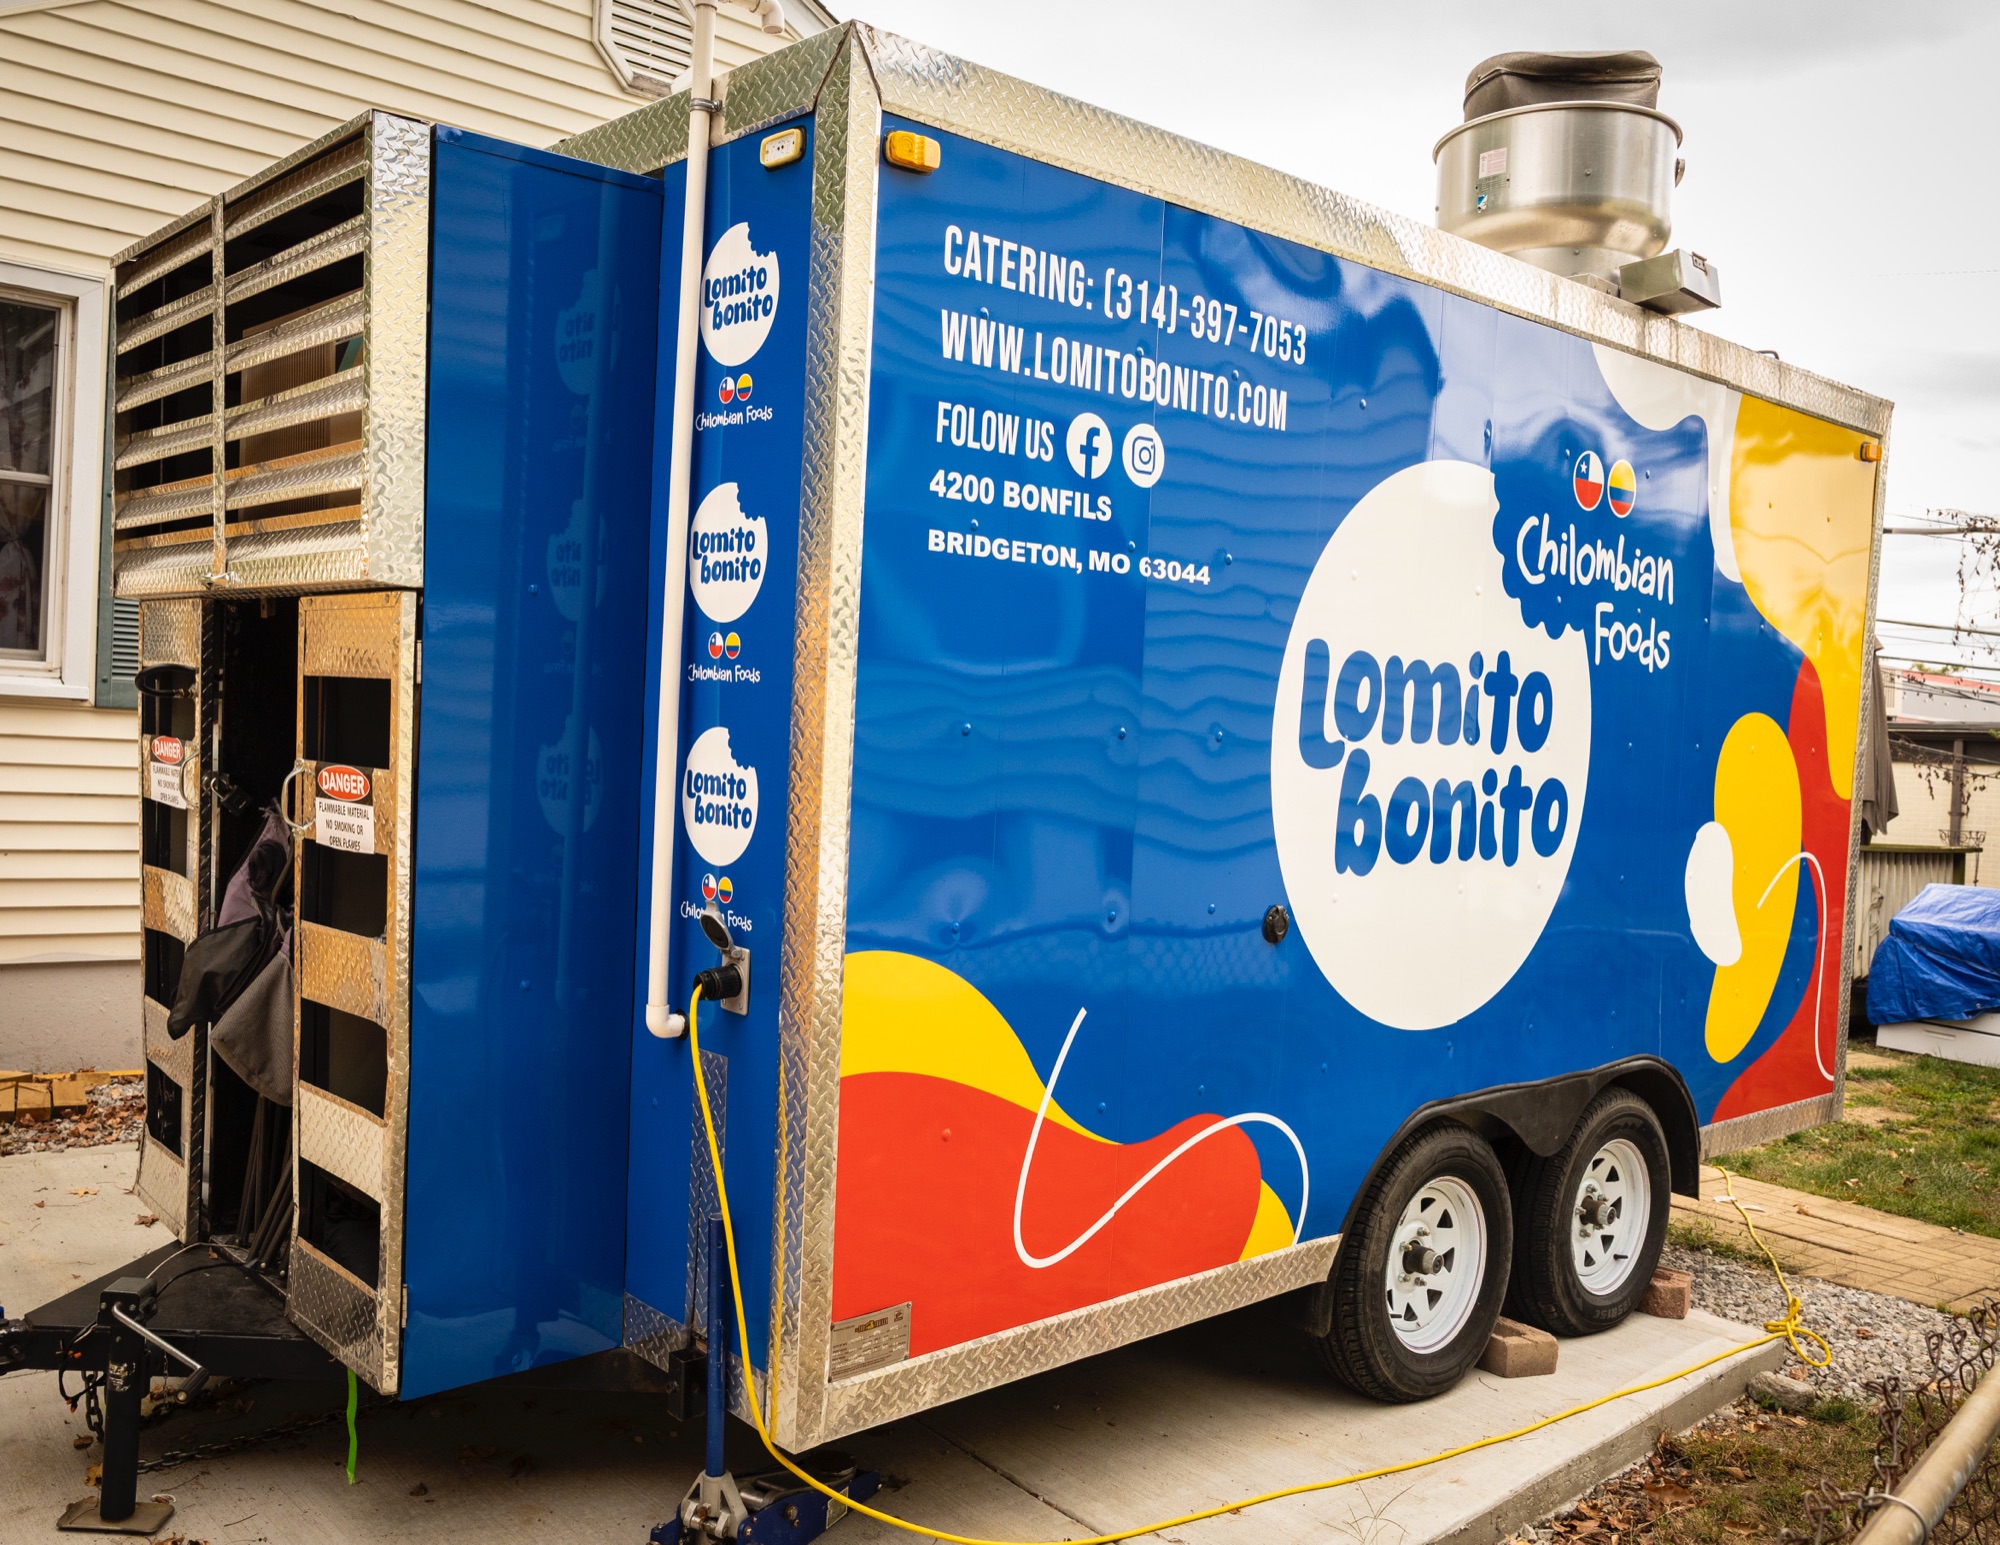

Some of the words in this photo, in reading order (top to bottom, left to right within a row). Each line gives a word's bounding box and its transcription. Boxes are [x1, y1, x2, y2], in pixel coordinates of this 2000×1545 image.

[704, 265, 767, 308] Lomito
[943, 225, 1094, 311] CATERING:
[1102, 267, 1307, 366] (314)-397-7053
[712, 293, 773, 331] bonito
[941, 308, 1288, 432] WWW.LOMITOBONITO.COM
[695, 410, 743, 431] Chilombian
[746, 405, 773, 422] Foods
[936, 400, 1019, 457] FOLOW
[1025, 420, 1055, 463] US
[929, 469, 995, 505] 4200
[1003, 480, 1112, 522] BONFILS
[693, 526, 755, 560] Lomito
[927, 530, 1082, 575] BRIDGETON,
[1087, 549, 1131, 575] MO
[1139, 557, 1211, 586] 63044
[1516, 512, 1674, 605] Chilombian
[700, 555, 761, 584] bonito
[1594, 602, 1671, 673] Foods
[735, 664, 761, 684] Foods
[1298, 638, 1553, 770] Lomito
[154, 739, 181, 759] DANGER
[321, 771, 365, 796] DANGER
[686, 769, 747, 800] Lomito
[318, 801, 346, 816] FLAMMABLE
[347, 805, 370, 820] MATERIAL
[325, 818, 333, 829] NO
[334, 820, 356, 834] SMOKING
[356, 824, 364, 836] OR
[694, 794, 753, 829] bonito
[1335, 747, 1569, 877] bonito
[329, 835, 342, 847] OPEN
[727, 910, 753, 932] Foods
